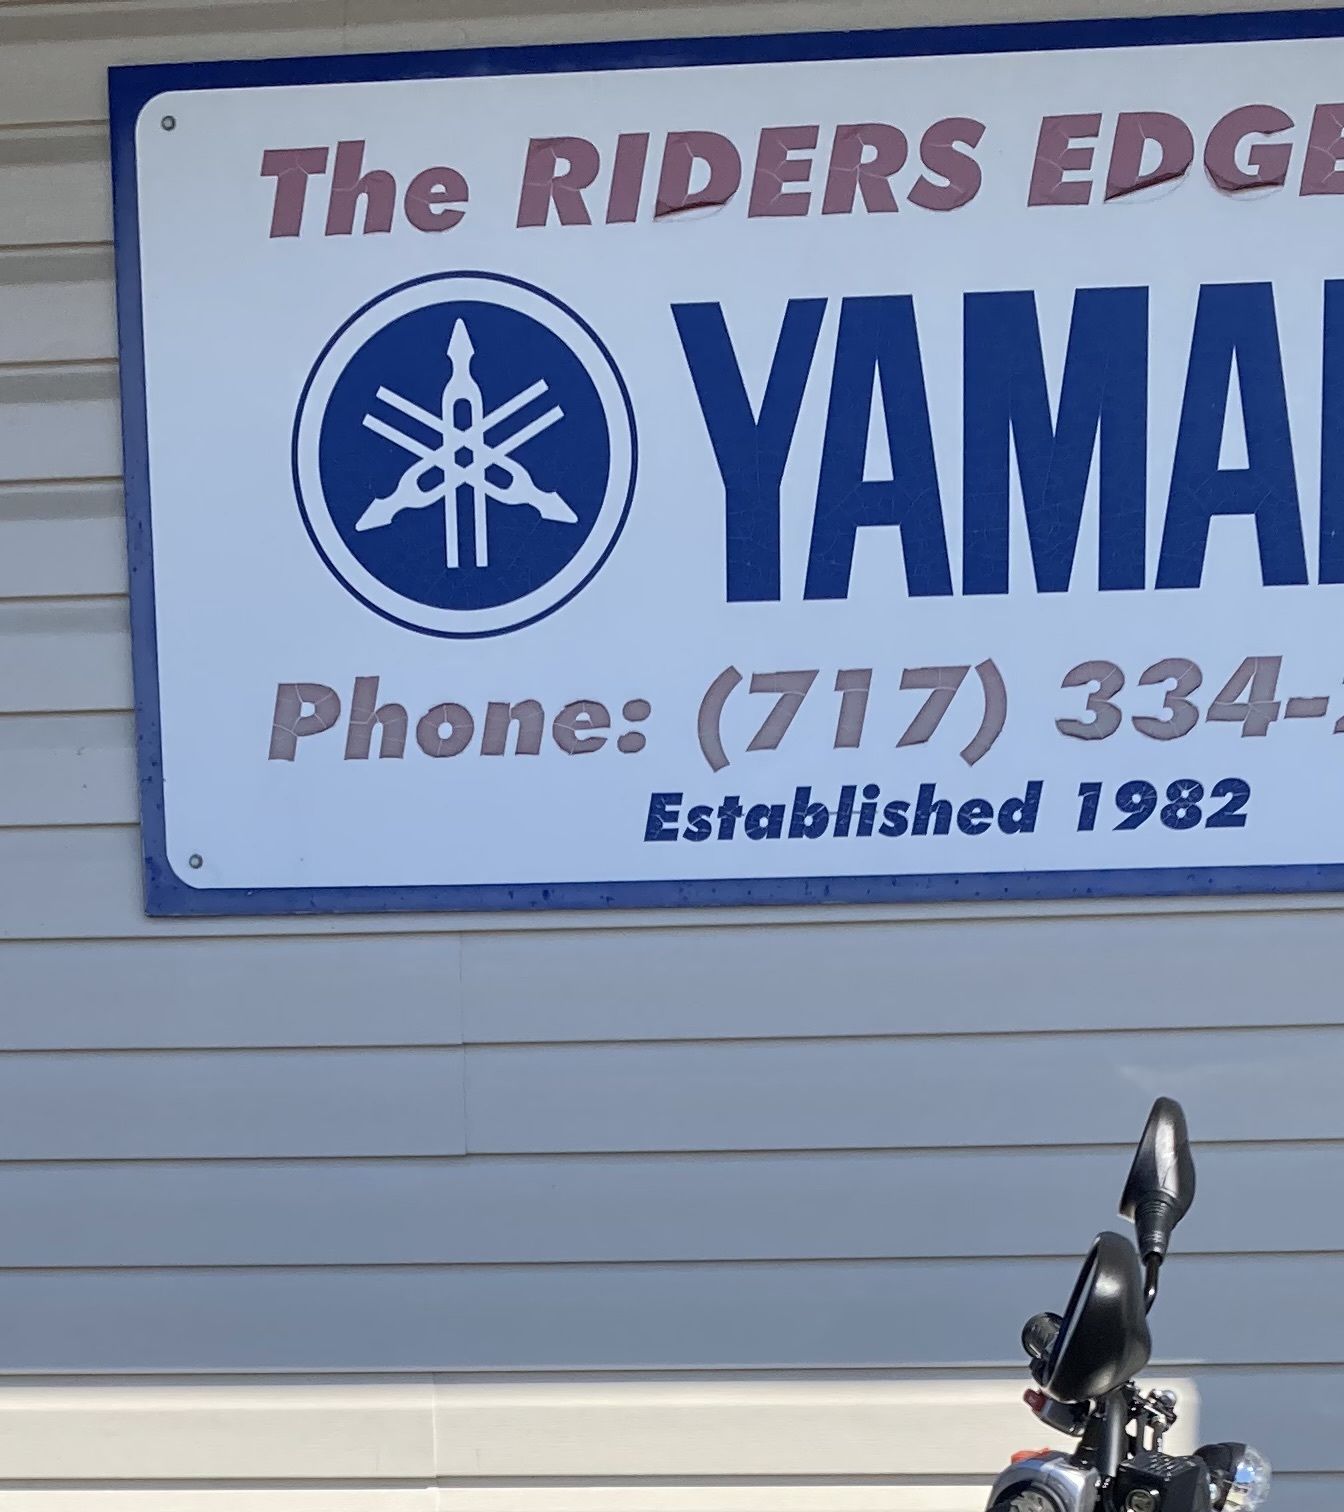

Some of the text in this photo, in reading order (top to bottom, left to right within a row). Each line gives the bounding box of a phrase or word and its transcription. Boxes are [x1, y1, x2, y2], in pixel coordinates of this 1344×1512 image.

[260, 140, 470, 239] The
[515, 117, 986, 229] RIDERS
[268, 675, 652, 762] Phone:
[698, 658, 1007, 772] (717)
[644, 778, 1251, 842] Established 1982
